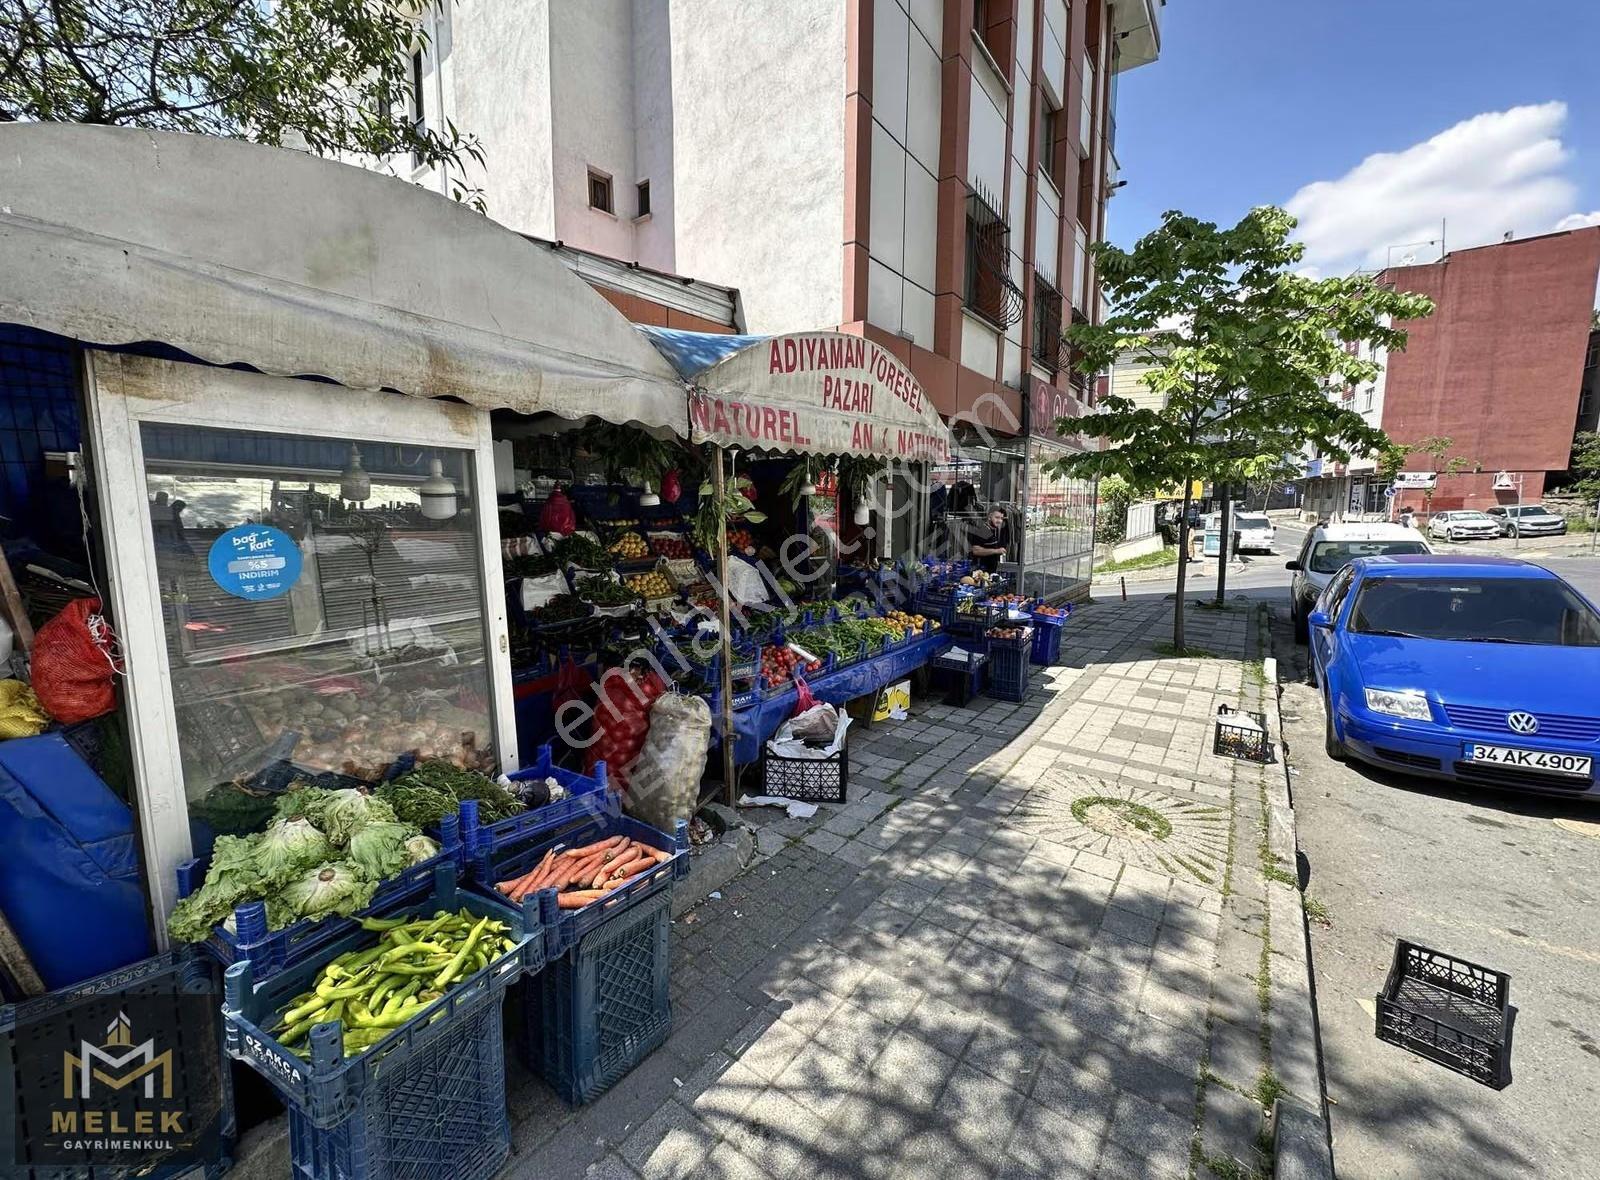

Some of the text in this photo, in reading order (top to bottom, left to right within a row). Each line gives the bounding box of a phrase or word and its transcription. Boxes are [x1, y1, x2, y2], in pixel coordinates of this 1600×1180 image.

[769, 337, 866, 375] ADIYAMAN
[822, 374, 874, 414] PAZARI
[249, 538, 275, 552] kart
[1474, 746, 1590, 772] 34 AK 4907
